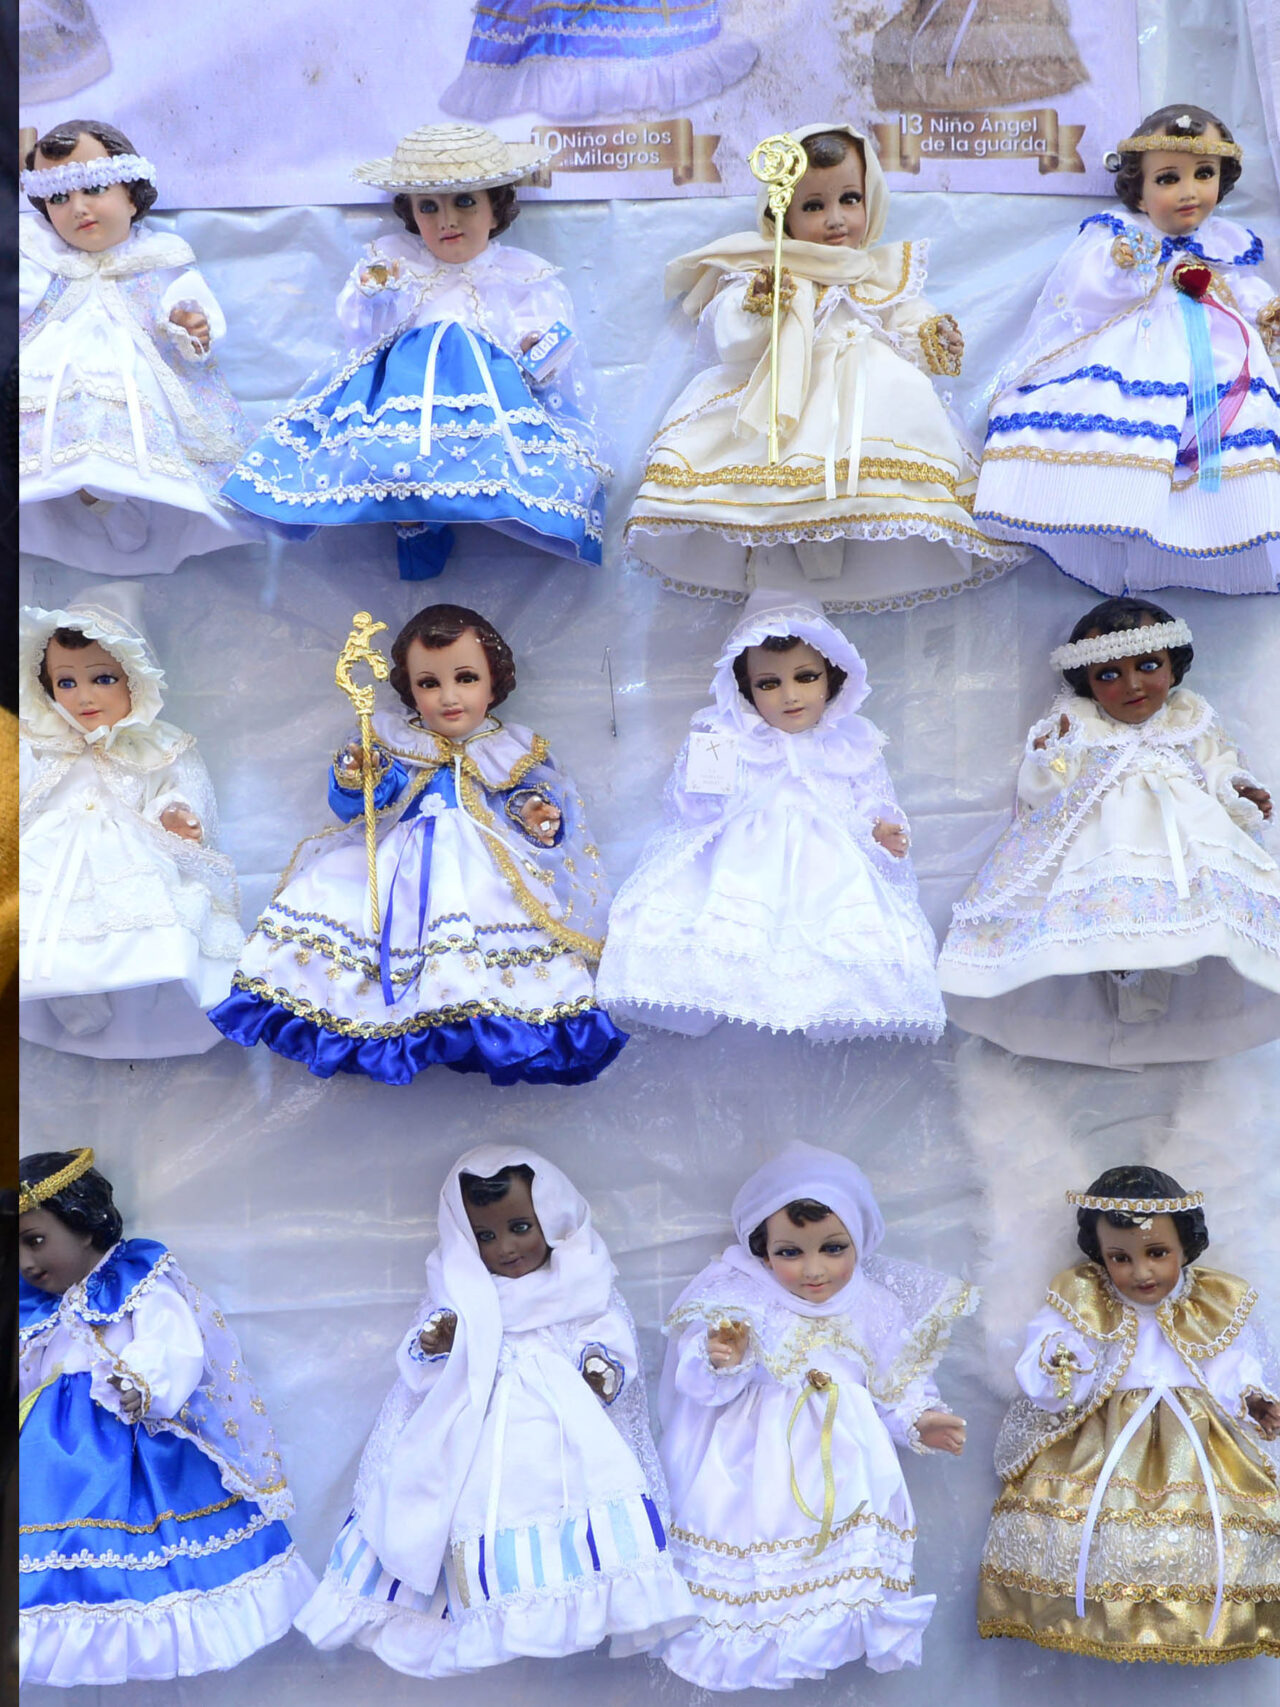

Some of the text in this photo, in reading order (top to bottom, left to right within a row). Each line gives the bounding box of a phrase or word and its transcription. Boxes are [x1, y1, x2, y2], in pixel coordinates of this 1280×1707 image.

[900, 113, 1037, 137] 13 Niño Ángel
[563, 131, 607, 148] Niño
[612, 129, 638, 146] de
[643, 127, 672, 144] los
[920, 136, 1047, 156] de la guarda
[574, 149, 660, 170] Milagros
